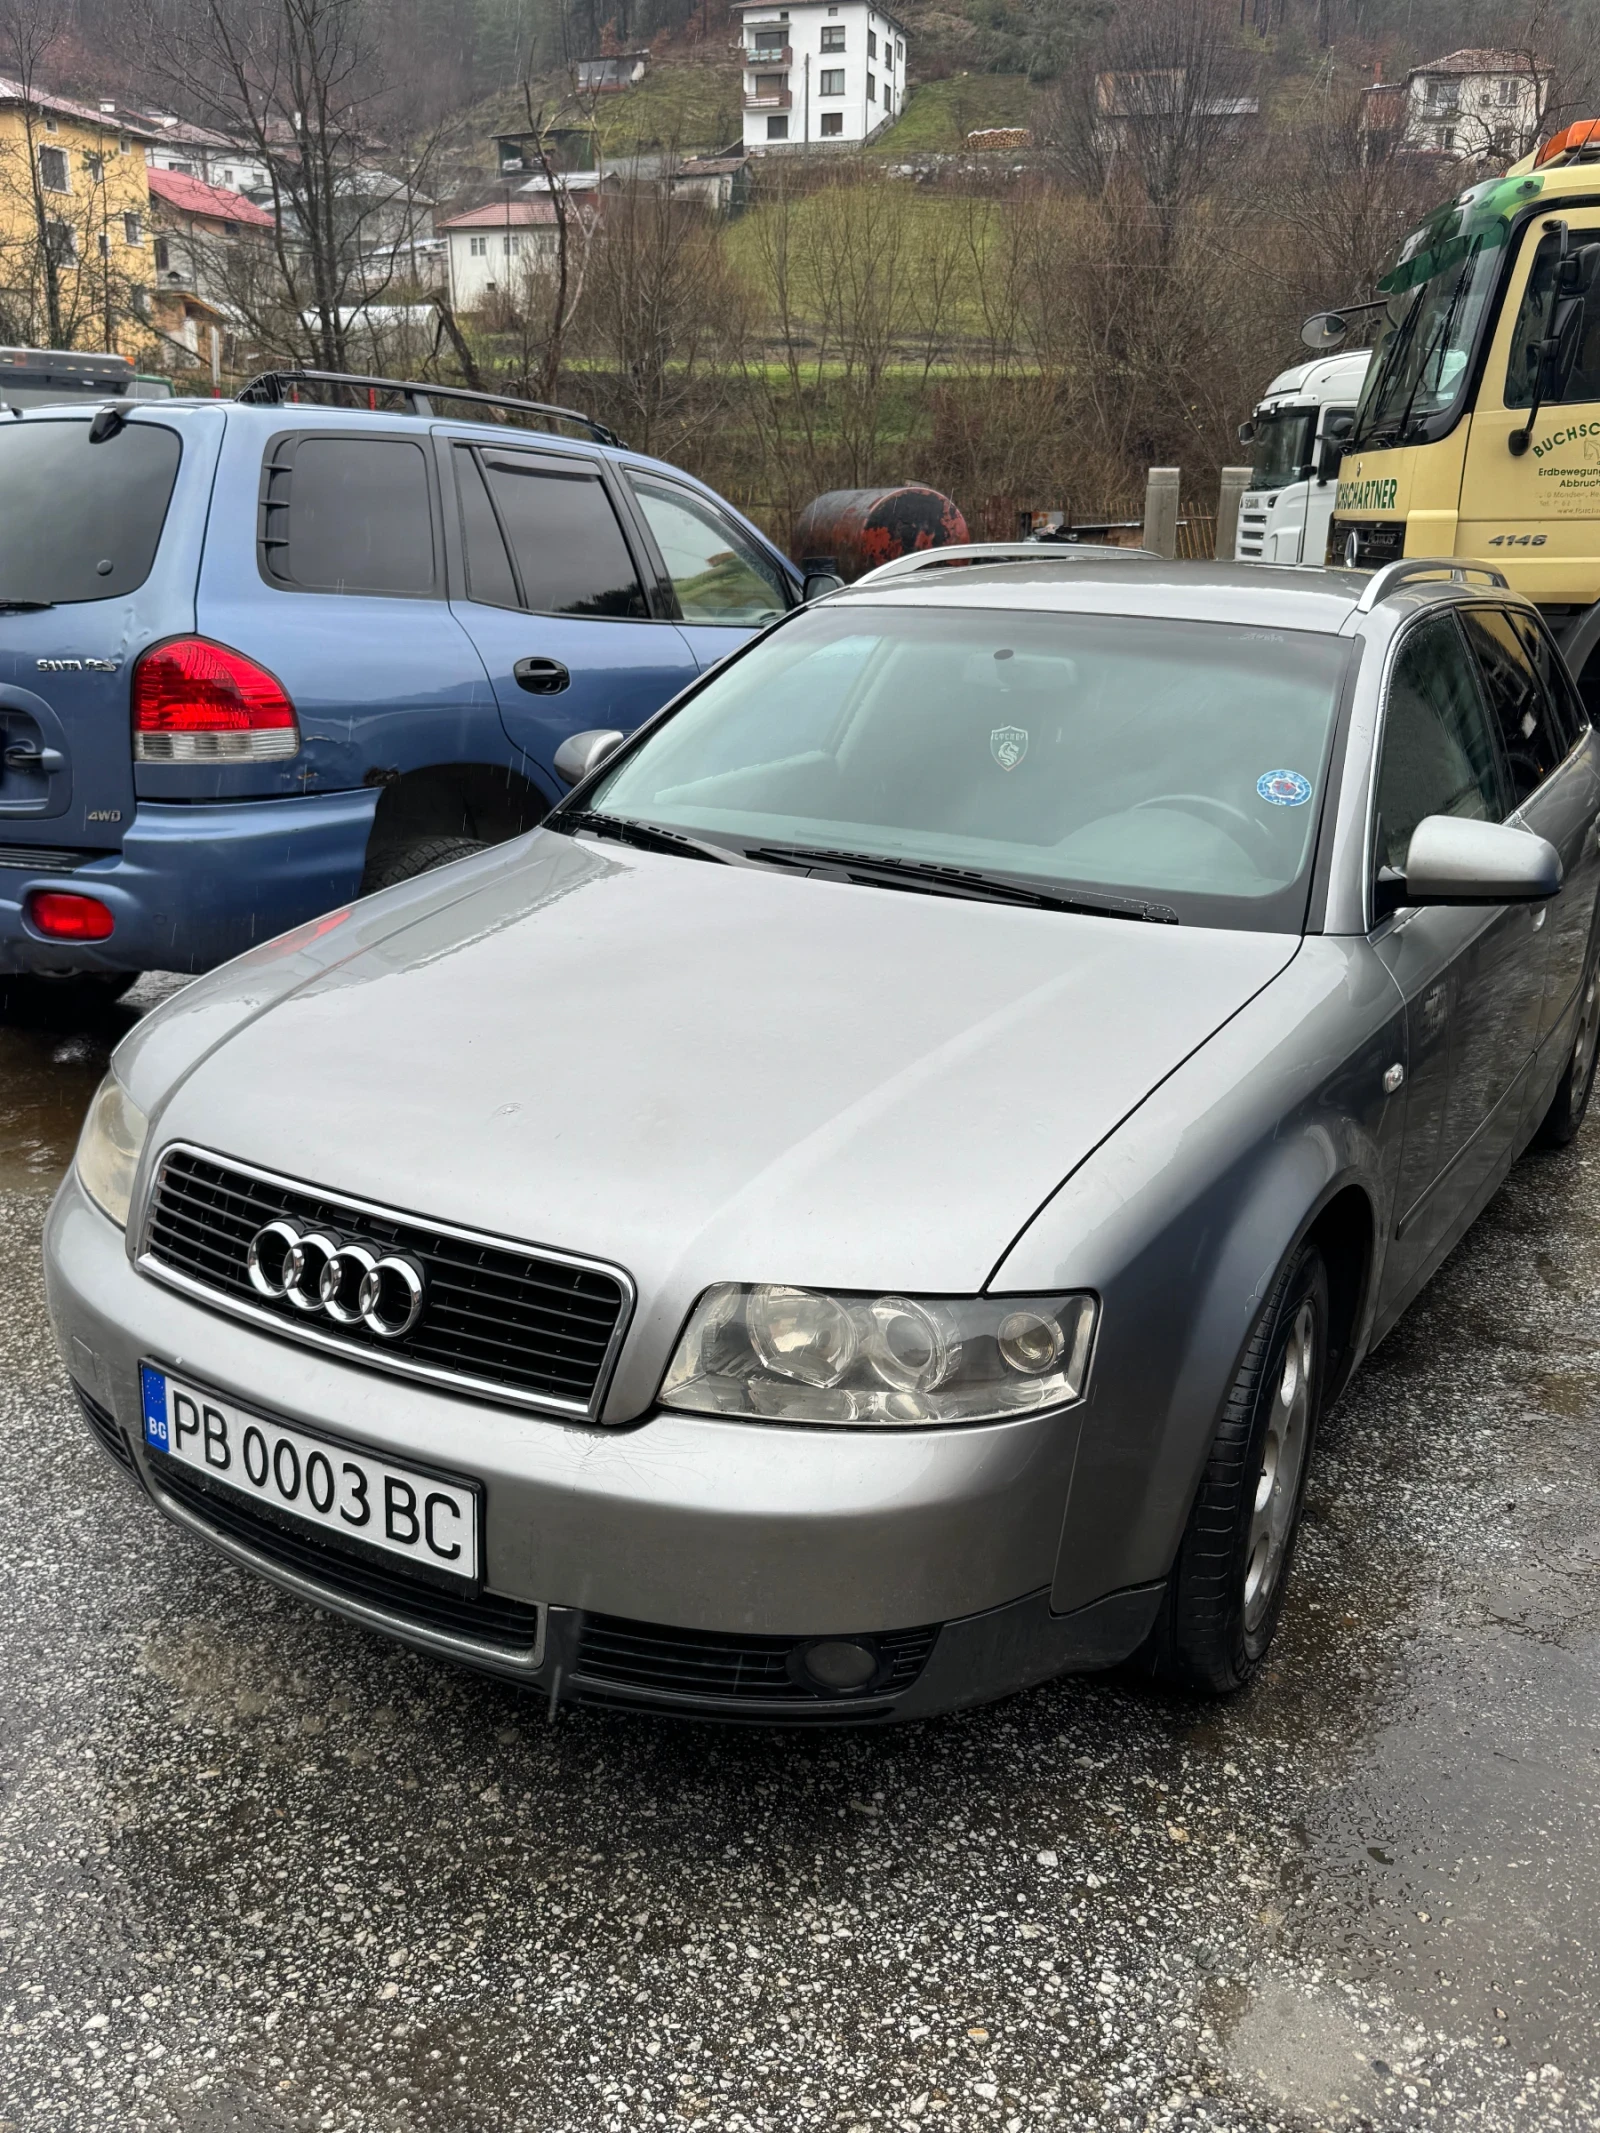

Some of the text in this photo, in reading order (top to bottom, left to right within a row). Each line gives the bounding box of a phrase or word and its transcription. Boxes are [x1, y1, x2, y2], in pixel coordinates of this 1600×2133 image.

[1488, 534, 1548, 546] 4146
[36, 658, 82, 672] SANTA
[87, 810, 122, 822] 4WD
[148, 1416, 167, 1441] BG
[173, 1389, 461, 1560] PB 0003 BC
